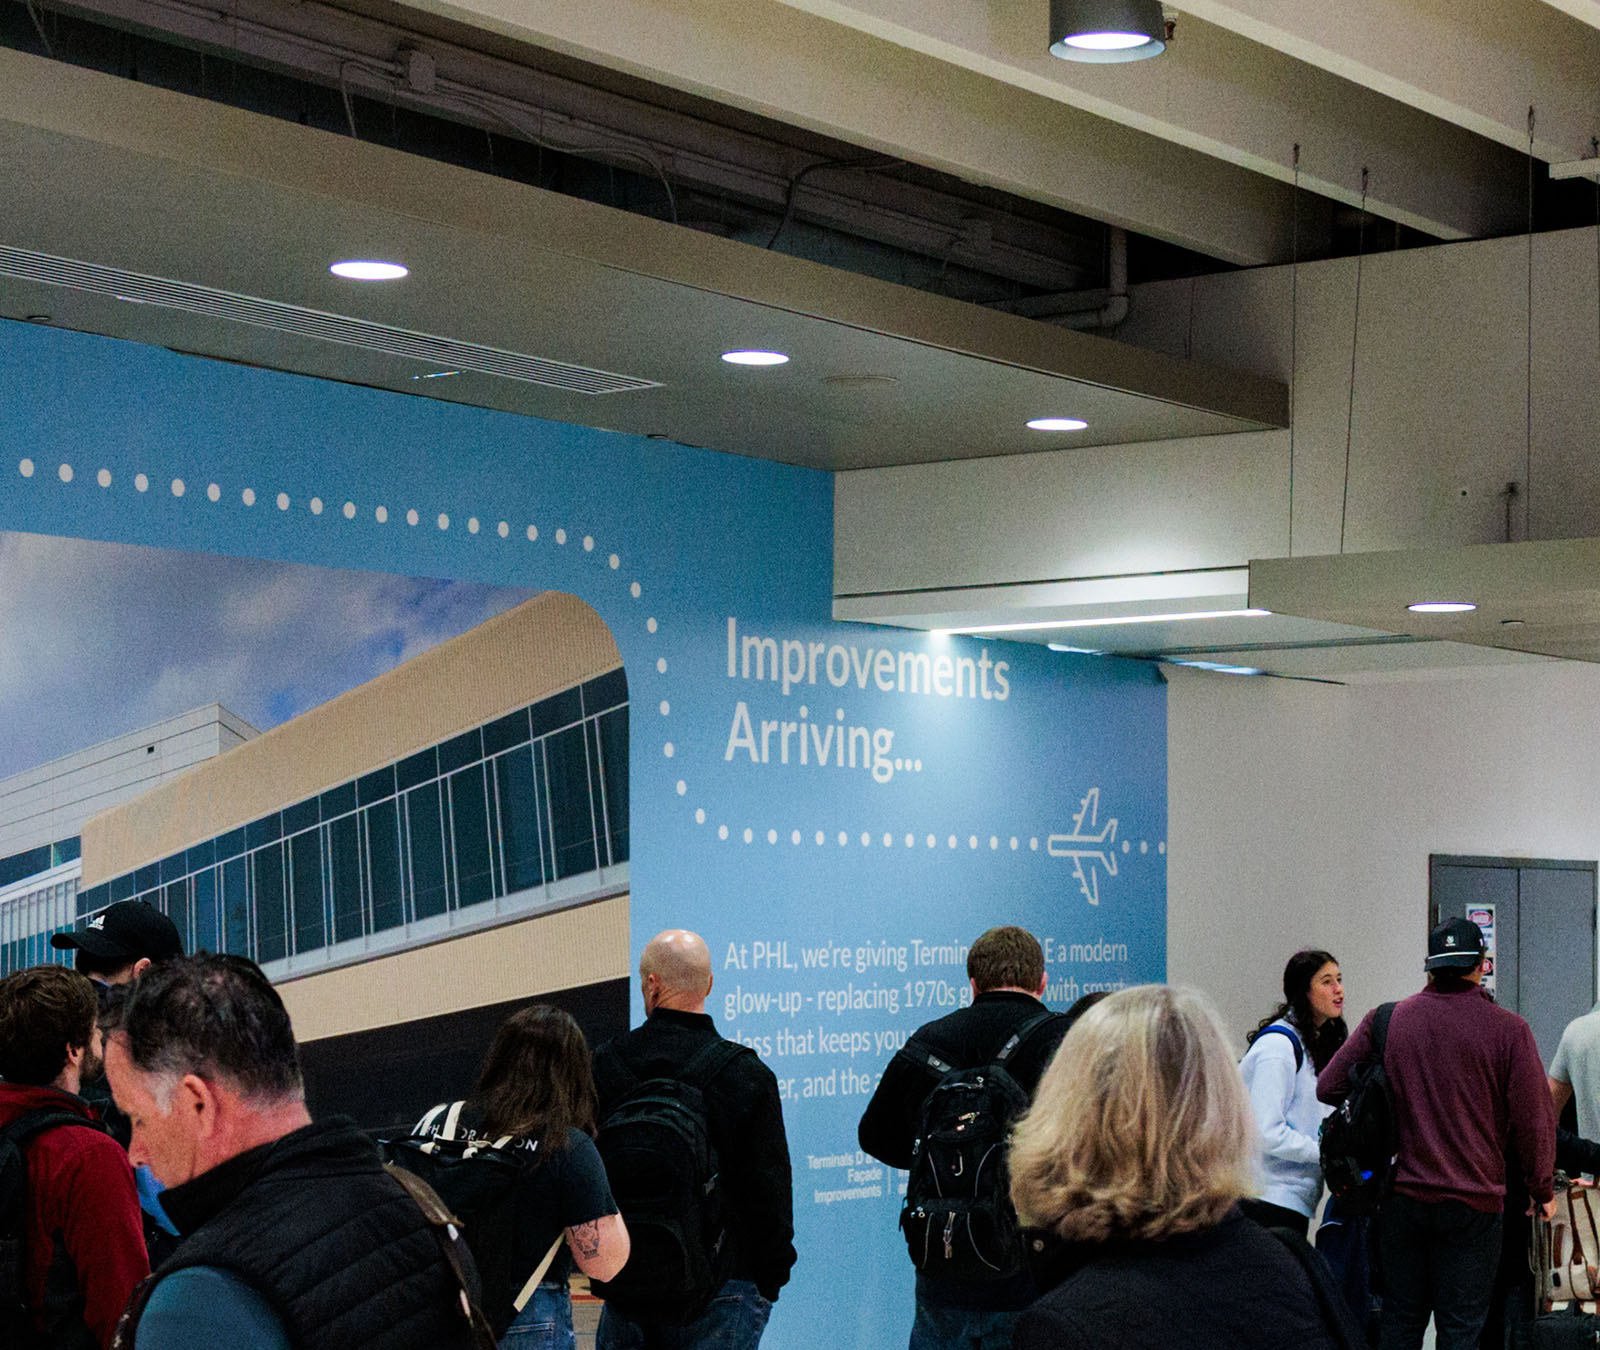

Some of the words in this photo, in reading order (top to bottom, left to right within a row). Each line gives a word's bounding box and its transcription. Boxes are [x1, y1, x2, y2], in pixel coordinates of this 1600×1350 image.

[727, 617, 1010, 701] Improvements
[724, 702, 923, 783] Arriving...
[724, 941, 748, 970] At
[753, 940, 798, 972] PHL,
[801, 940, 851, 969] we're
[855, 939, 908, 973] giving
[910, 939, 969, 966] Termin
[1044, 937, 1054, 962] E
[1058, 944, 1067, 962] a
[1069, 936, 1128, 962] modern
[724, 984, 802, 1021] glow-up
[817, 981, 899, 1014] replacing
[903, 980, 956, 1007] 1970s
[1045, 976, 1079, 1002] with
[726, 1029, 772, 1057] lass
[776, 1027, 814, 1056] that
[819, 1026, 871, 1057] keeps
[776, 1077, 799, 1101] er,
[803, 1069, 837, 1098] and
[841, 1066, 870, 1094] the
[808, 1153, 854, 1169] Terminals
[856, 1150, 864, 1165] D
[848, 1167, 882, 1185] Façade
[815, 1185, 882, 1206] Improvements
